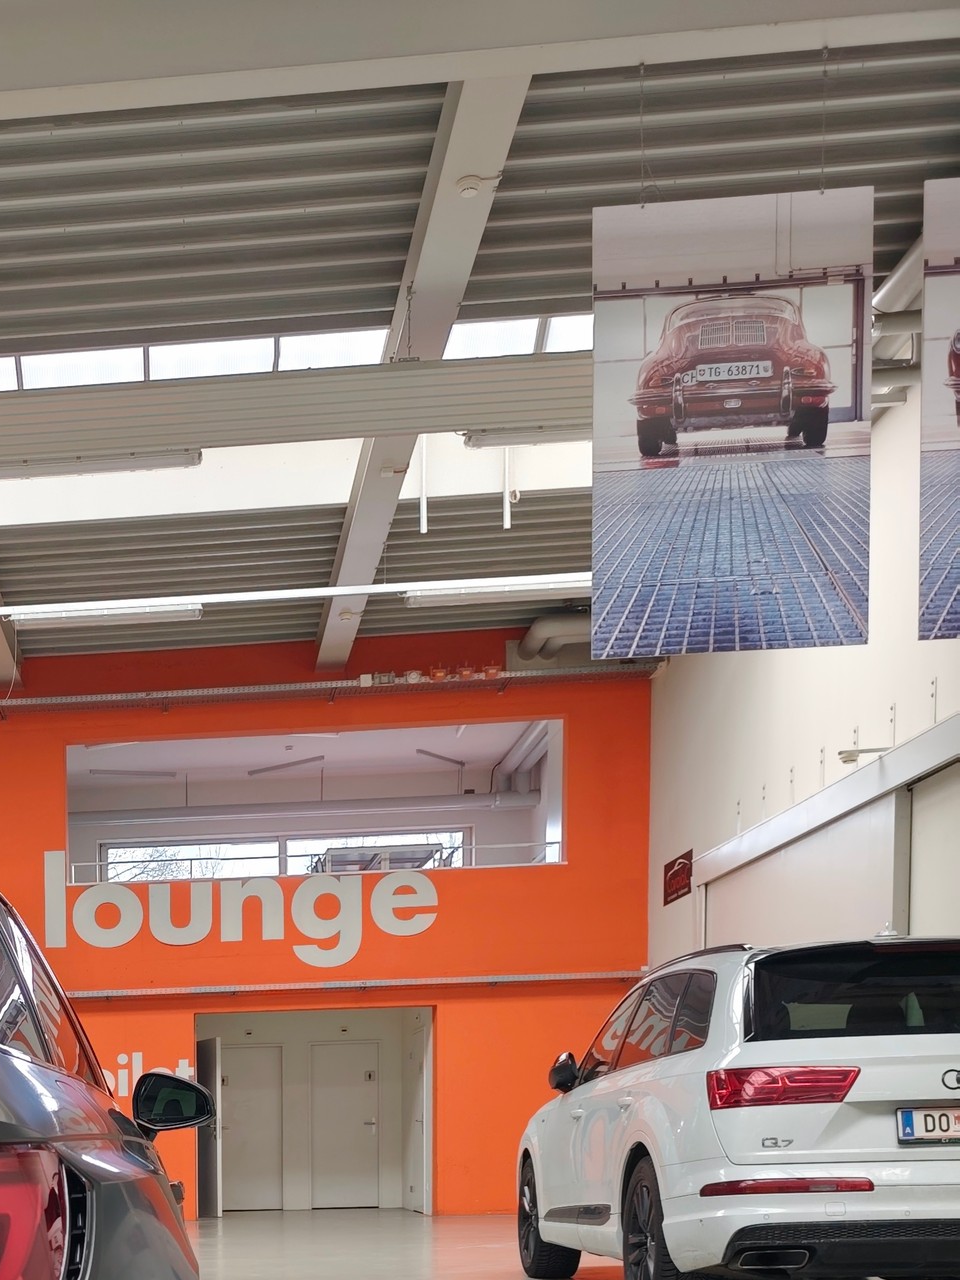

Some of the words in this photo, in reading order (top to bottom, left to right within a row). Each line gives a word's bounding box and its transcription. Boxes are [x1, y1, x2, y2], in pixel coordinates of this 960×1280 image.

[44, 850, 438, 968] lounge
[905, 1126, 912, 1134] A
[923, 1112, 950, 1133] DO
[761, 1137, 794, 1148] Q7
